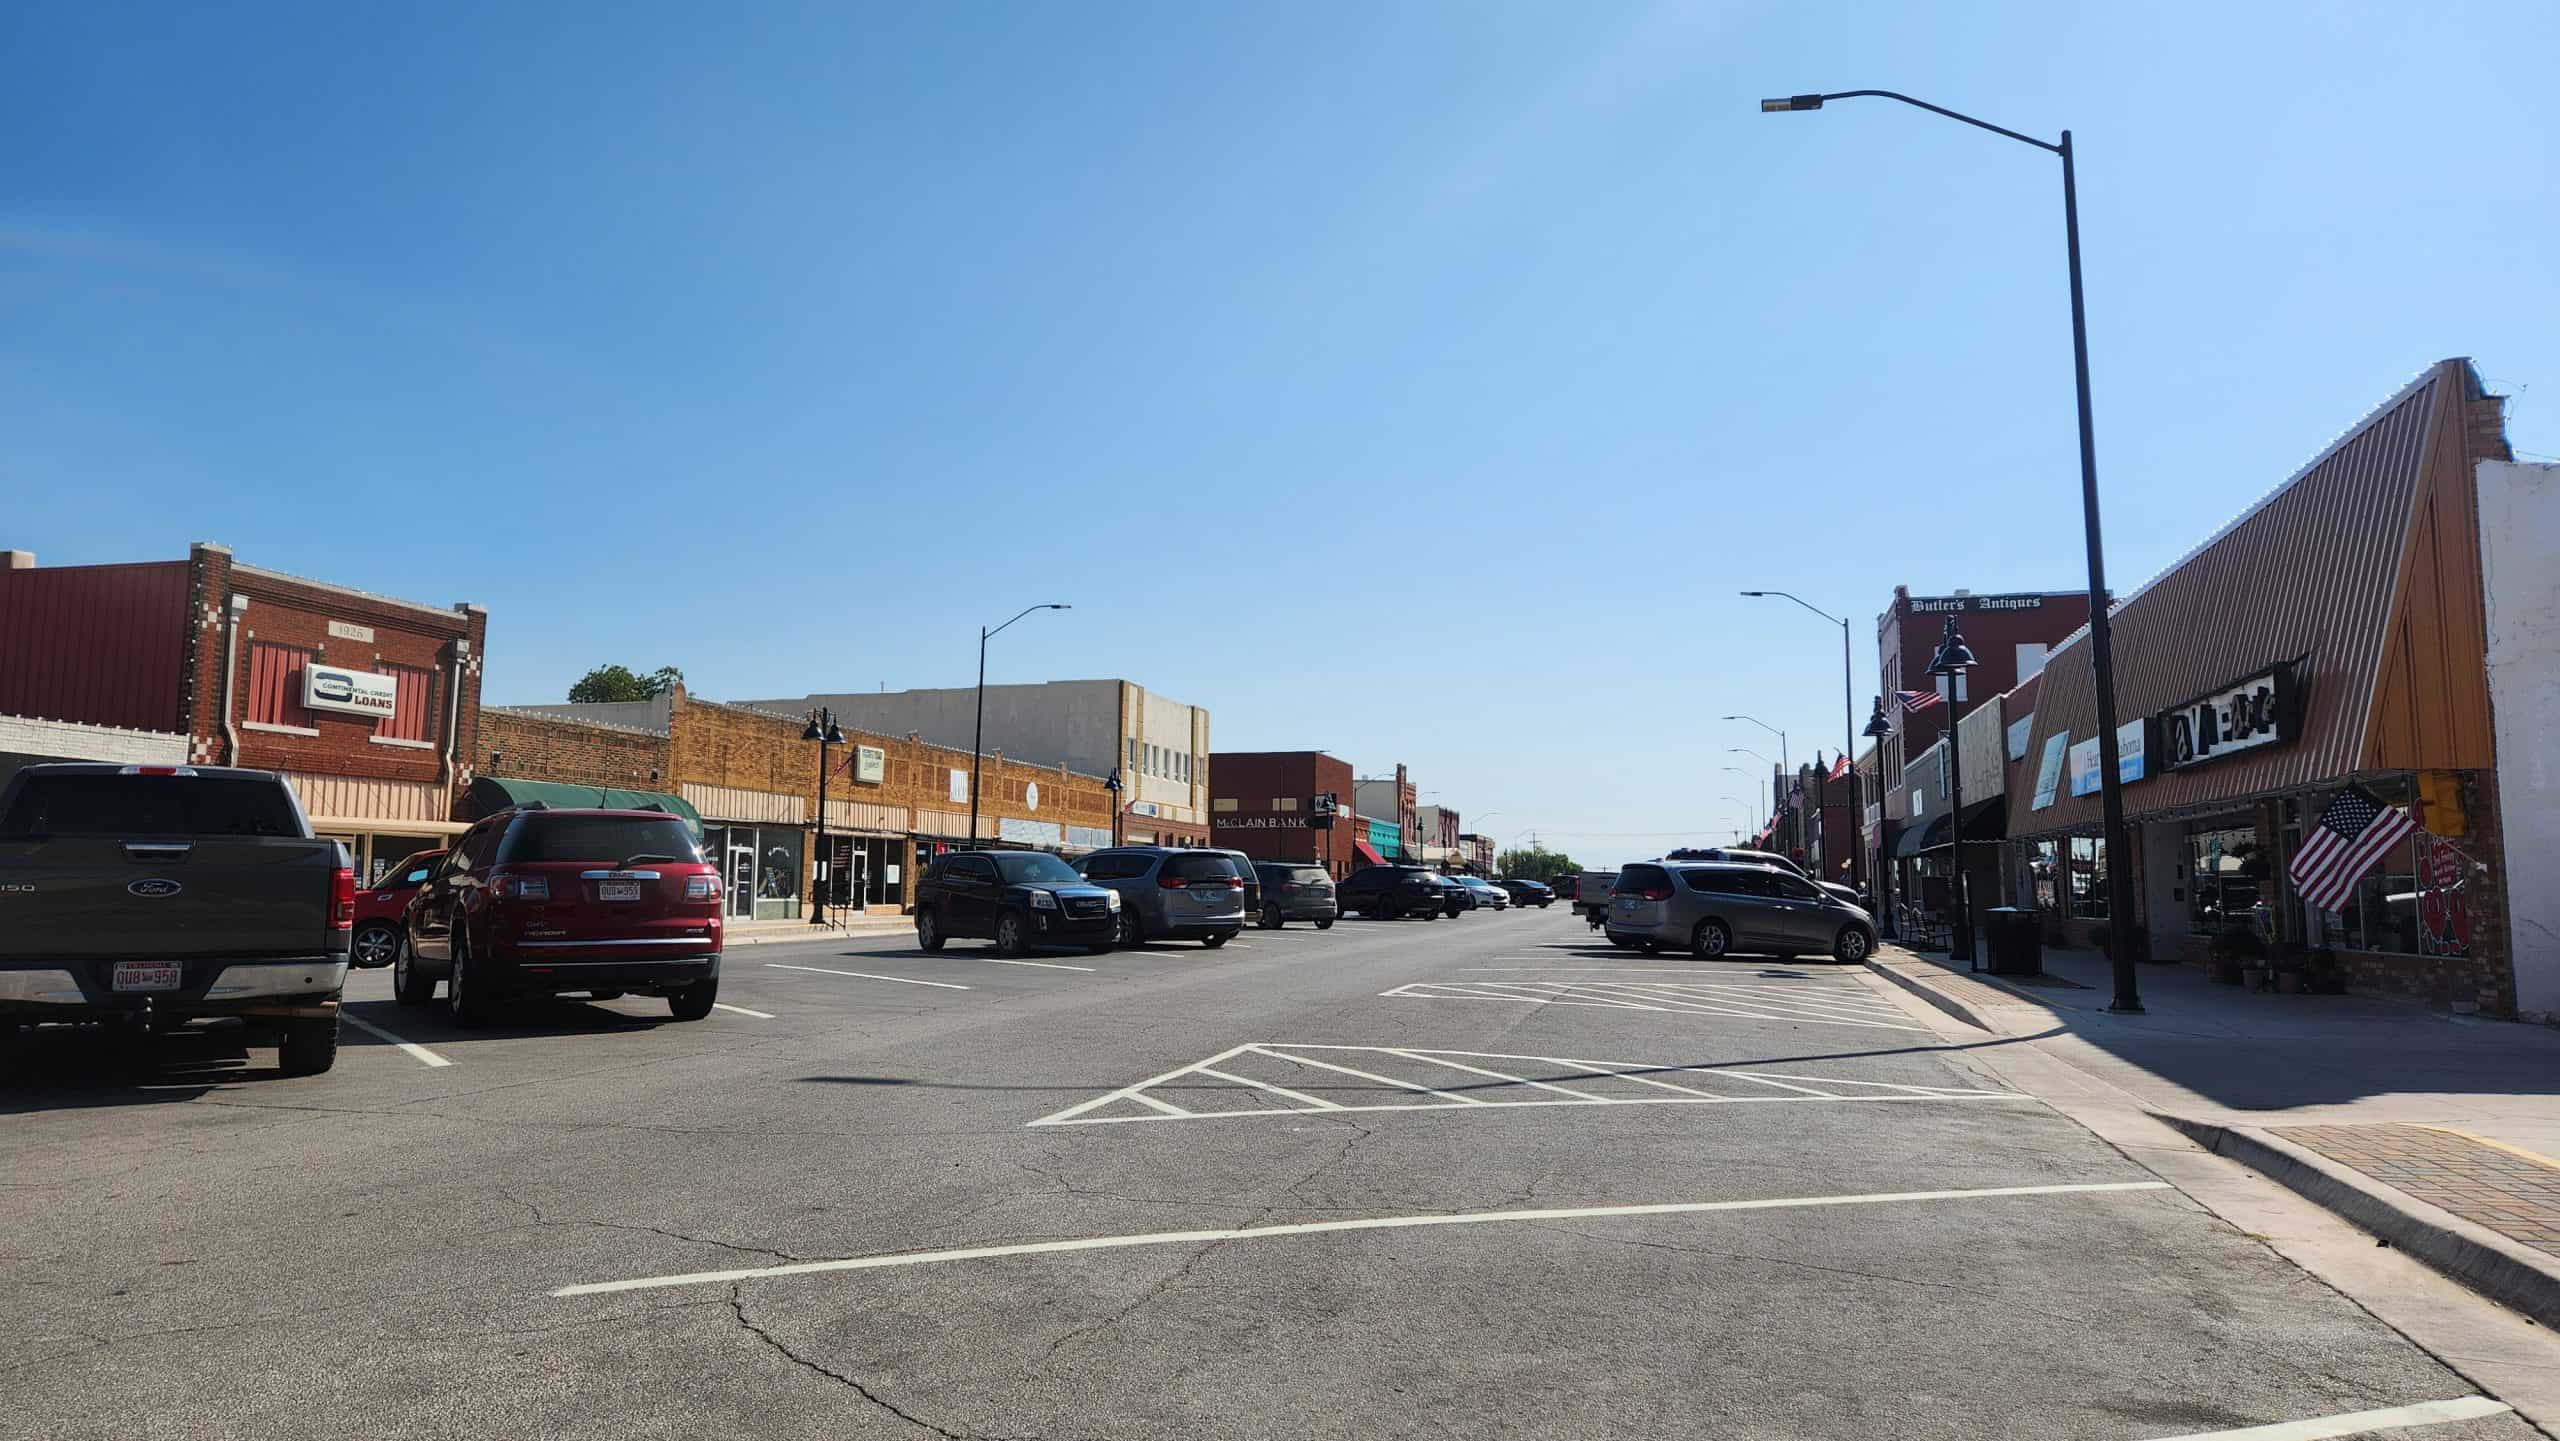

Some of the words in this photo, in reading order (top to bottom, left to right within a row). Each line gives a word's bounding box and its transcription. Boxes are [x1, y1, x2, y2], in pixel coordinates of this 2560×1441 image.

[1911, 599, 1965, 613] Butler's
[1979, 597, 2041, 610] Antiques
[354, 695, 393, 710] LOANS
[1268, 817, 1308, 829] BANK
[139, 882, 168, 894] Ford
